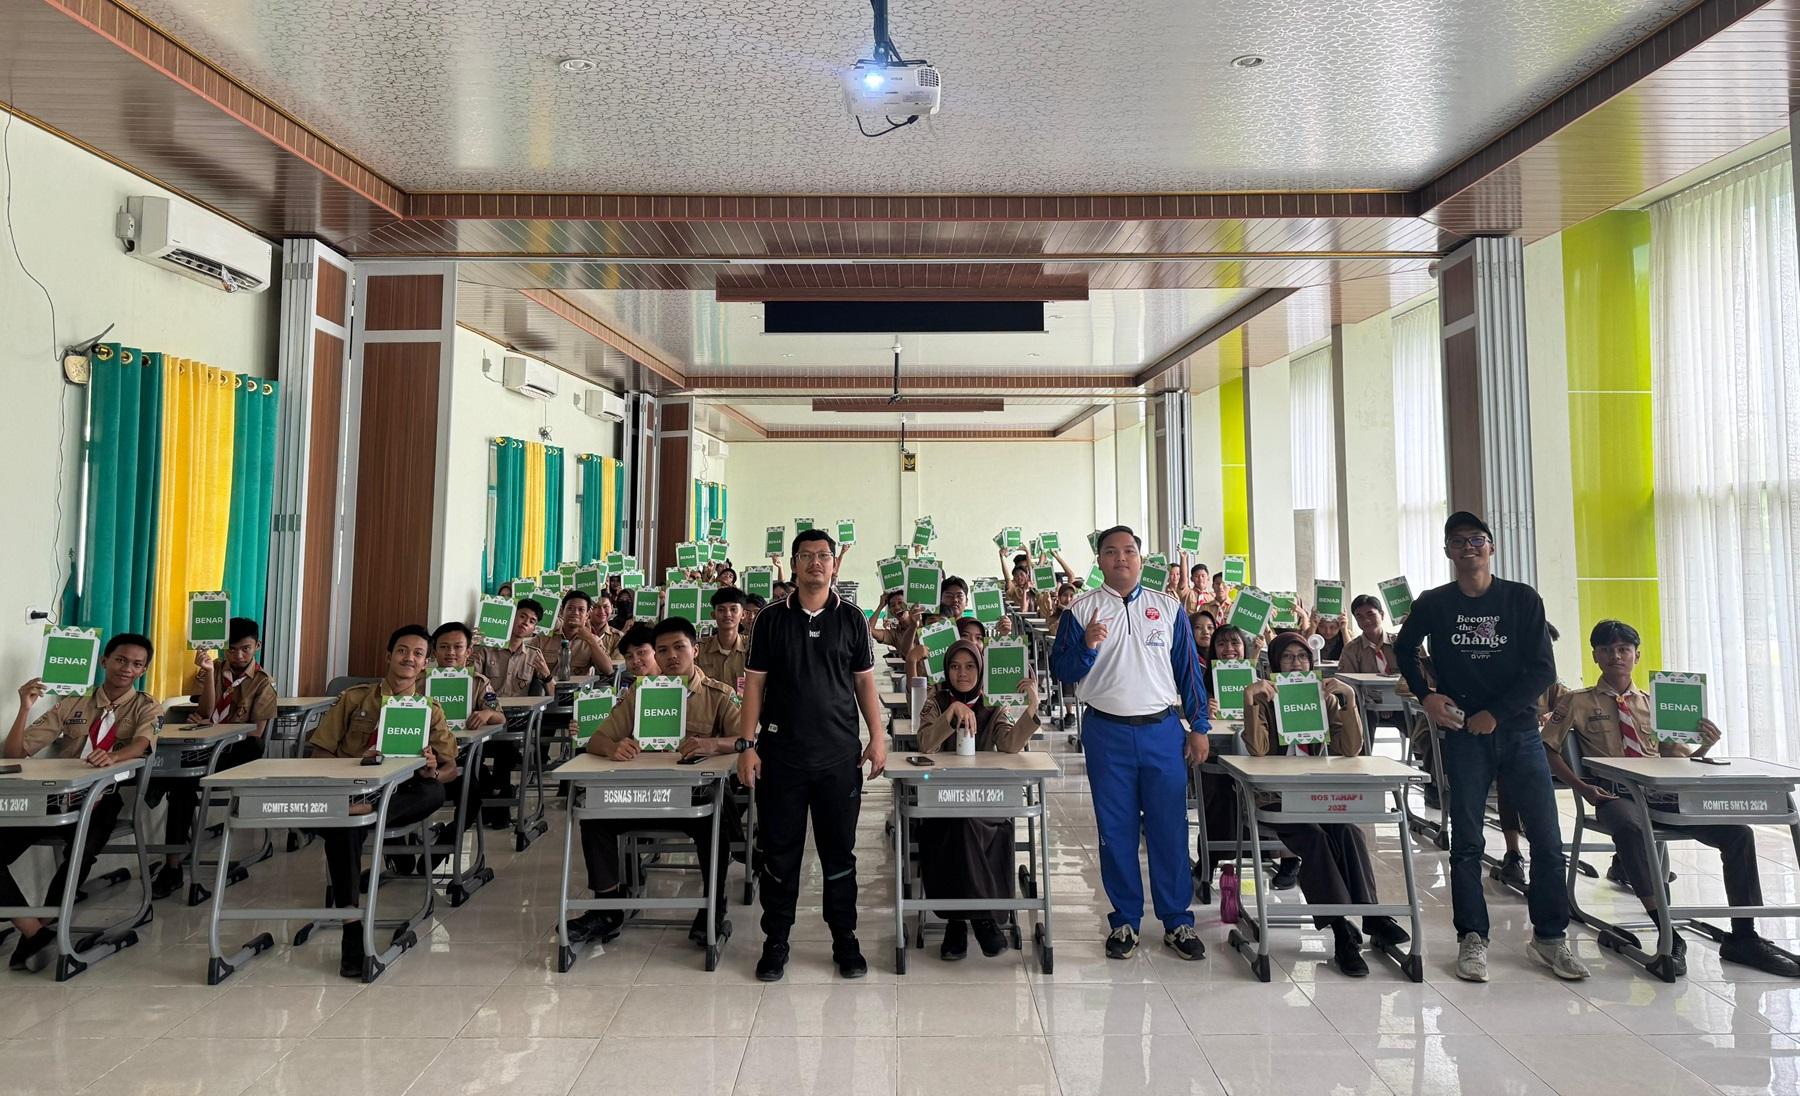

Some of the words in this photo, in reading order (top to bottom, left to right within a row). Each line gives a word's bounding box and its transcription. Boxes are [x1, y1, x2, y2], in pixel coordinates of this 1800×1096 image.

[1142, 576, 1162, 586] BENAR
[1389, 595, 1409, 606] BENAR
[1237, 606, 1263, 622] BENAR
[1456, 614, 1500, 623] Become
[482, 616, 508, 625] BENAR
[1451, 633, 1508, 648] Change
[929, 646, 948, 658] BENA
[49, 656, 88, 666] BENAR
[991, 666, 1021, 675] BENAR
[643, 708, 678, 717] BENAR
[1283, 703, 1318, 713] BENAR
[1659, 702, 1698, 713] BENAR
[387, 727, 421, 736] BENAR
[938, 789, 965, 803] KOMITE
[965, 788, 985, 803] SMT.1
[986, 788, 1004, 802] 20/21
[9, 797, 29, 812] 20/21
[262, 802, 288, 813] KOMITE
[289, 802, 309, 813] SMT.1
[310, 802, 328, 813] 20/21
[1702, 800, 1729, 811] KOMITE
